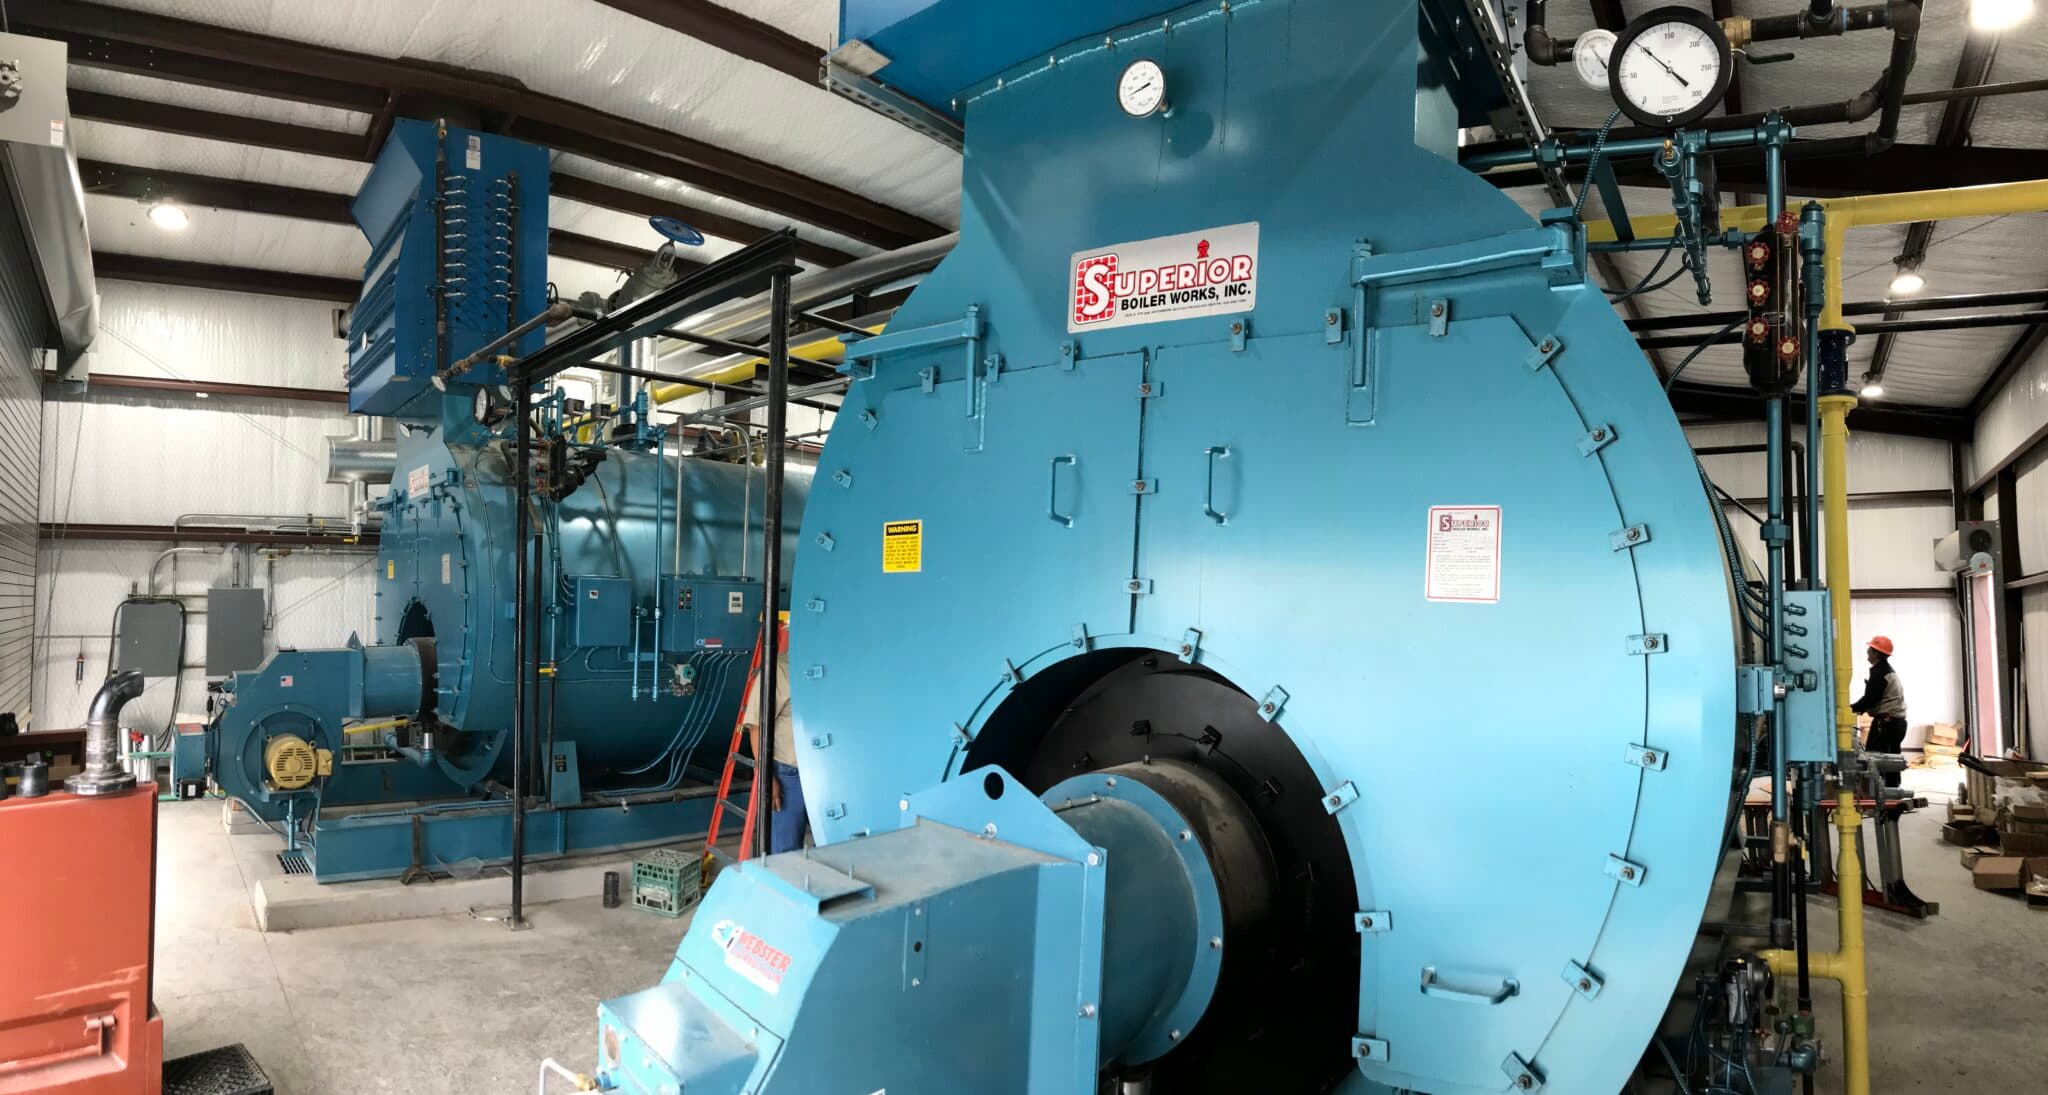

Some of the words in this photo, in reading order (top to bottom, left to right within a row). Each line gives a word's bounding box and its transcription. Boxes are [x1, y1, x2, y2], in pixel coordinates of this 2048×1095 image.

[1664, 32, 1675, 40] 150
[1701, 64, 1712, 72] 250
[1691, 90, 1702, 98] 300
[1082, 254, 1253, 317] SUPERIOR
[1121, 291, 1166, 311] BOILER
[1170, 286, 1220, 305] WORKS,
[1225, 283, 1251, 297] INC.
[888, 525, 917, 533] WARNING
[739, 931, 792, 972] WEBSTER
